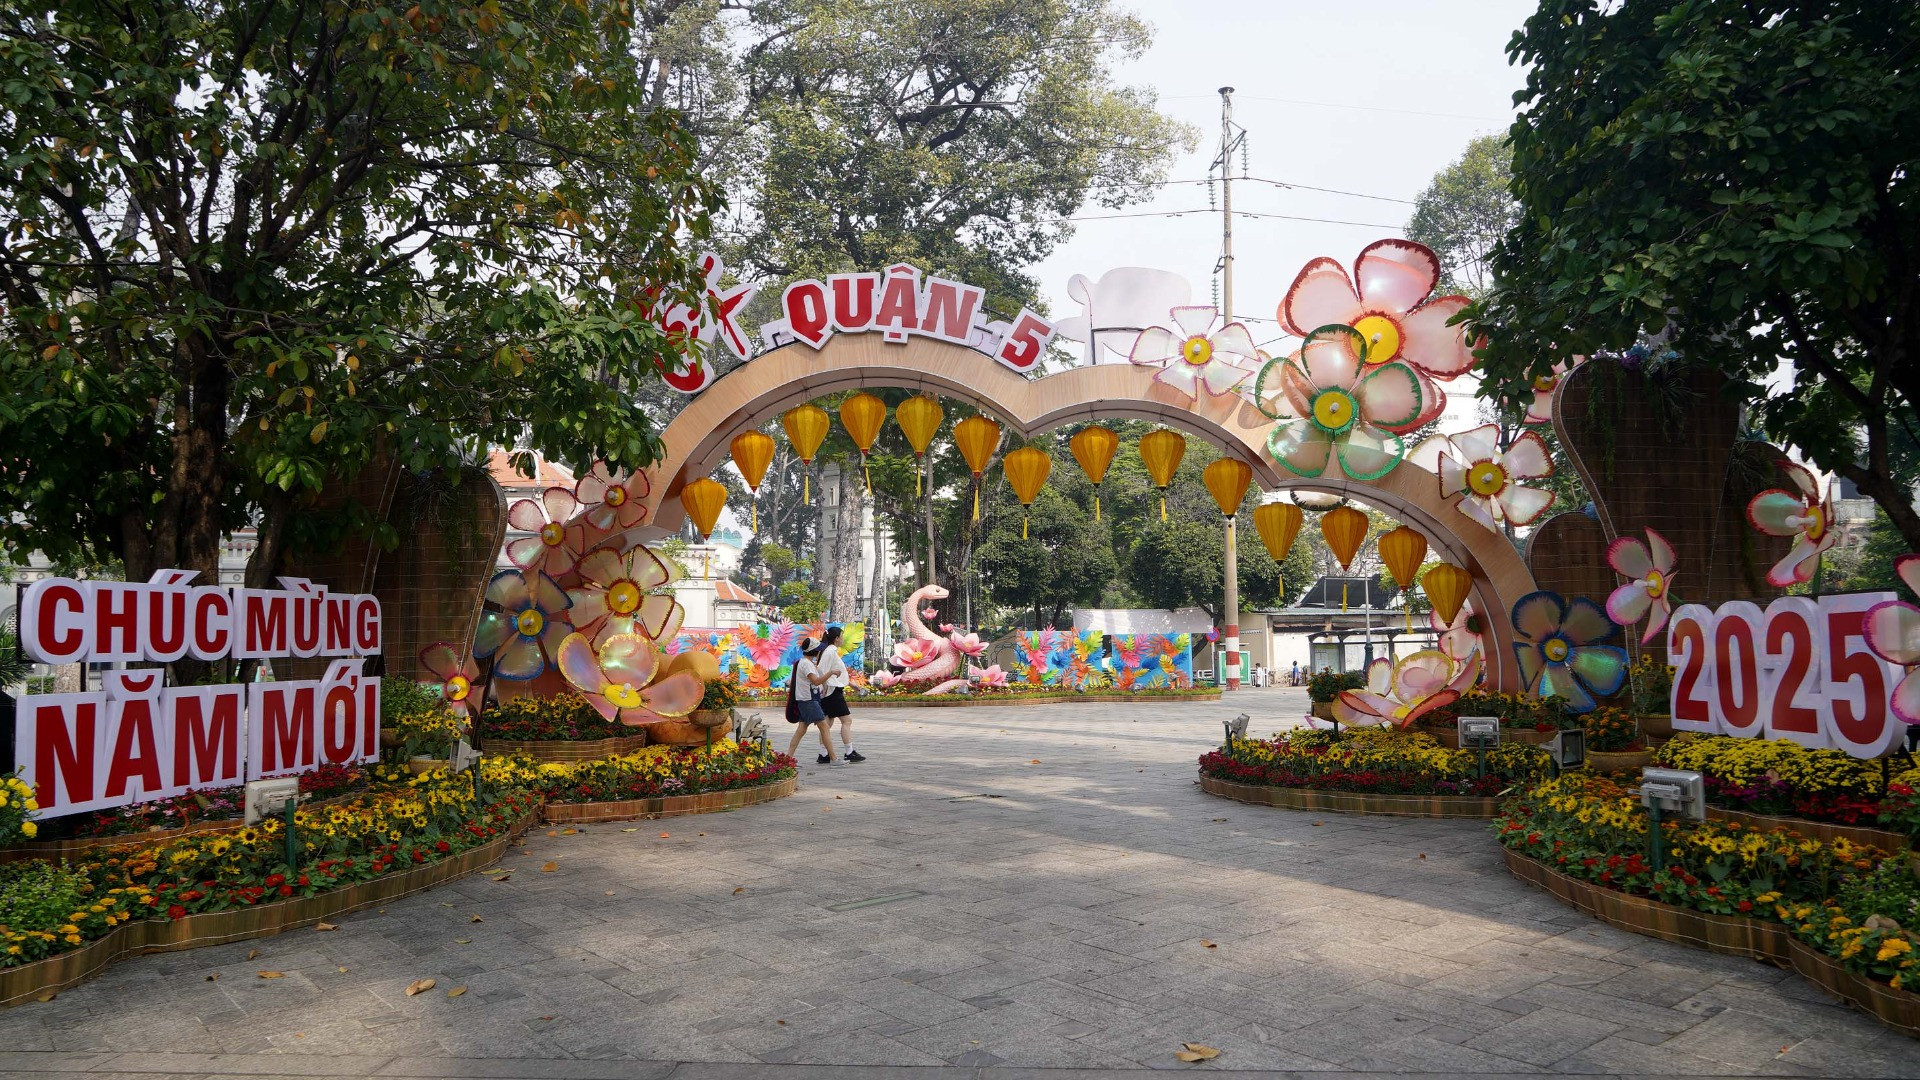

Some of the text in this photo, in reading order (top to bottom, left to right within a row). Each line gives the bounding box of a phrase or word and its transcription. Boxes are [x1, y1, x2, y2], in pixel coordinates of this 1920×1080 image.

[786, 266, 978, 343] QUẬN
[1001, 317, 1050, 368] 5
[38, 574, 378, 656] CHÚC MỪNG
[1671, 611, 1886, 745] 2025
[35, 666, 376, 809] NĂM MỚI
